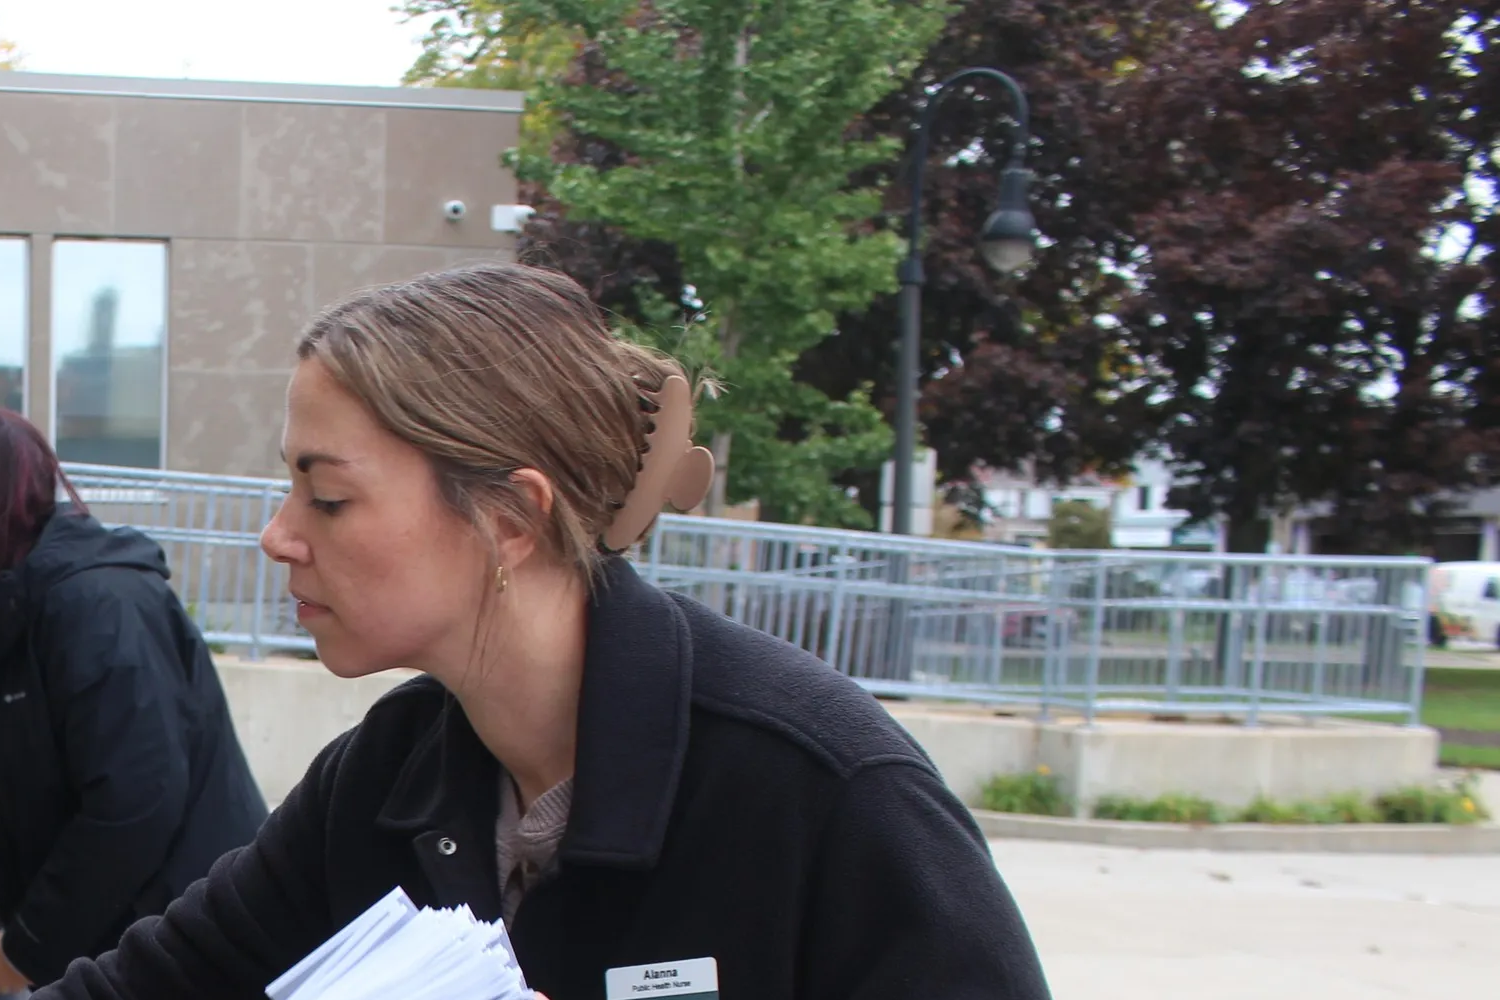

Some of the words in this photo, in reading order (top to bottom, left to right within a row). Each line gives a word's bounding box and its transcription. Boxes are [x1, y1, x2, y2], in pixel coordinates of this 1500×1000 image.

[643, 968, 678, 980] Alanna
[632, 984, 650, 992] Public
[652, 982, 671, 990] Health
[673, 980, 691, 988] Nurse
